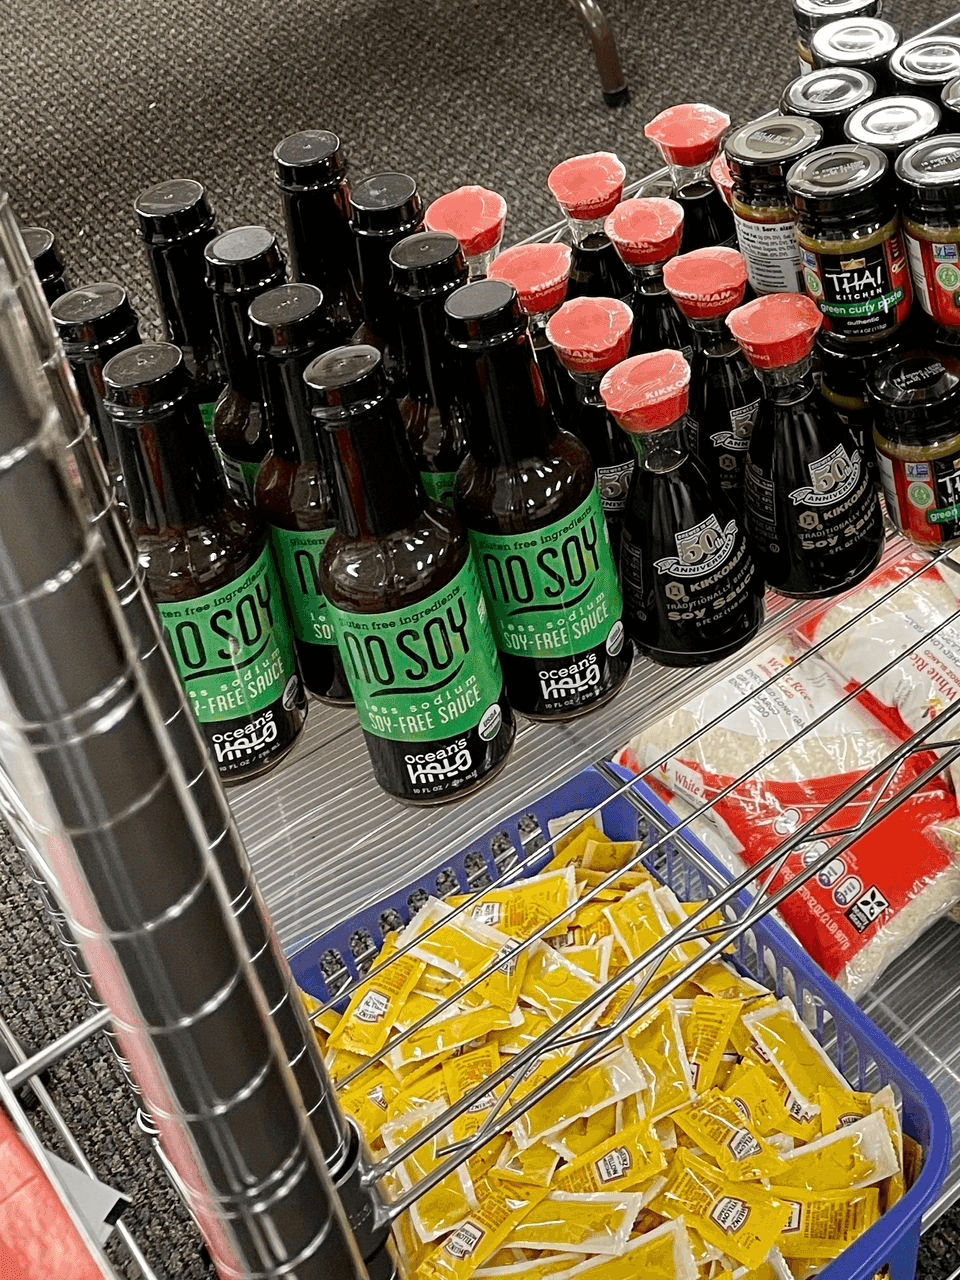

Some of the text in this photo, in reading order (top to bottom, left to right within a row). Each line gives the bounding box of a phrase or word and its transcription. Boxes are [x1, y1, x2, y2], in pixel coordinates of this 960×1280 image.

[824, 265, 882, 294] THAI
[835, 286, 883, 301] KITCHEN
[820, 303, 847, 314] green
[848, 303, 876, 315] curry
[846, 316, 880, 326] authentic
[513, 505, 593, 552] free ingredients
[929, 507, 958, 522] green
[536, 516, 600, 598] SOY
[672, 534, 734, 574] ANNIVERSARY
[689, 535, 747, 593] KIKKOMAN
[185, 564, 266, 617] free ingredients
[371, 585, 461, 631] free ingredients
[545, 591, 606, 630] sodium
[209, 575, 275, 660] SOY
[396, 596, 470, 680] SOY
[503, 600, 610, 651] SOY-FREE SAUCE
[220, 647, 280, 693] sodium
[249, 656, 285, 699] SAUCE
[927, 667, 958, 702] White
[368, 684, 482, 735] SOY-FREE SAUCE
[409, 674, 477, 713] sodium
[404, 737, 468, 764] ocean's
[675, 770, 700, 795] White
